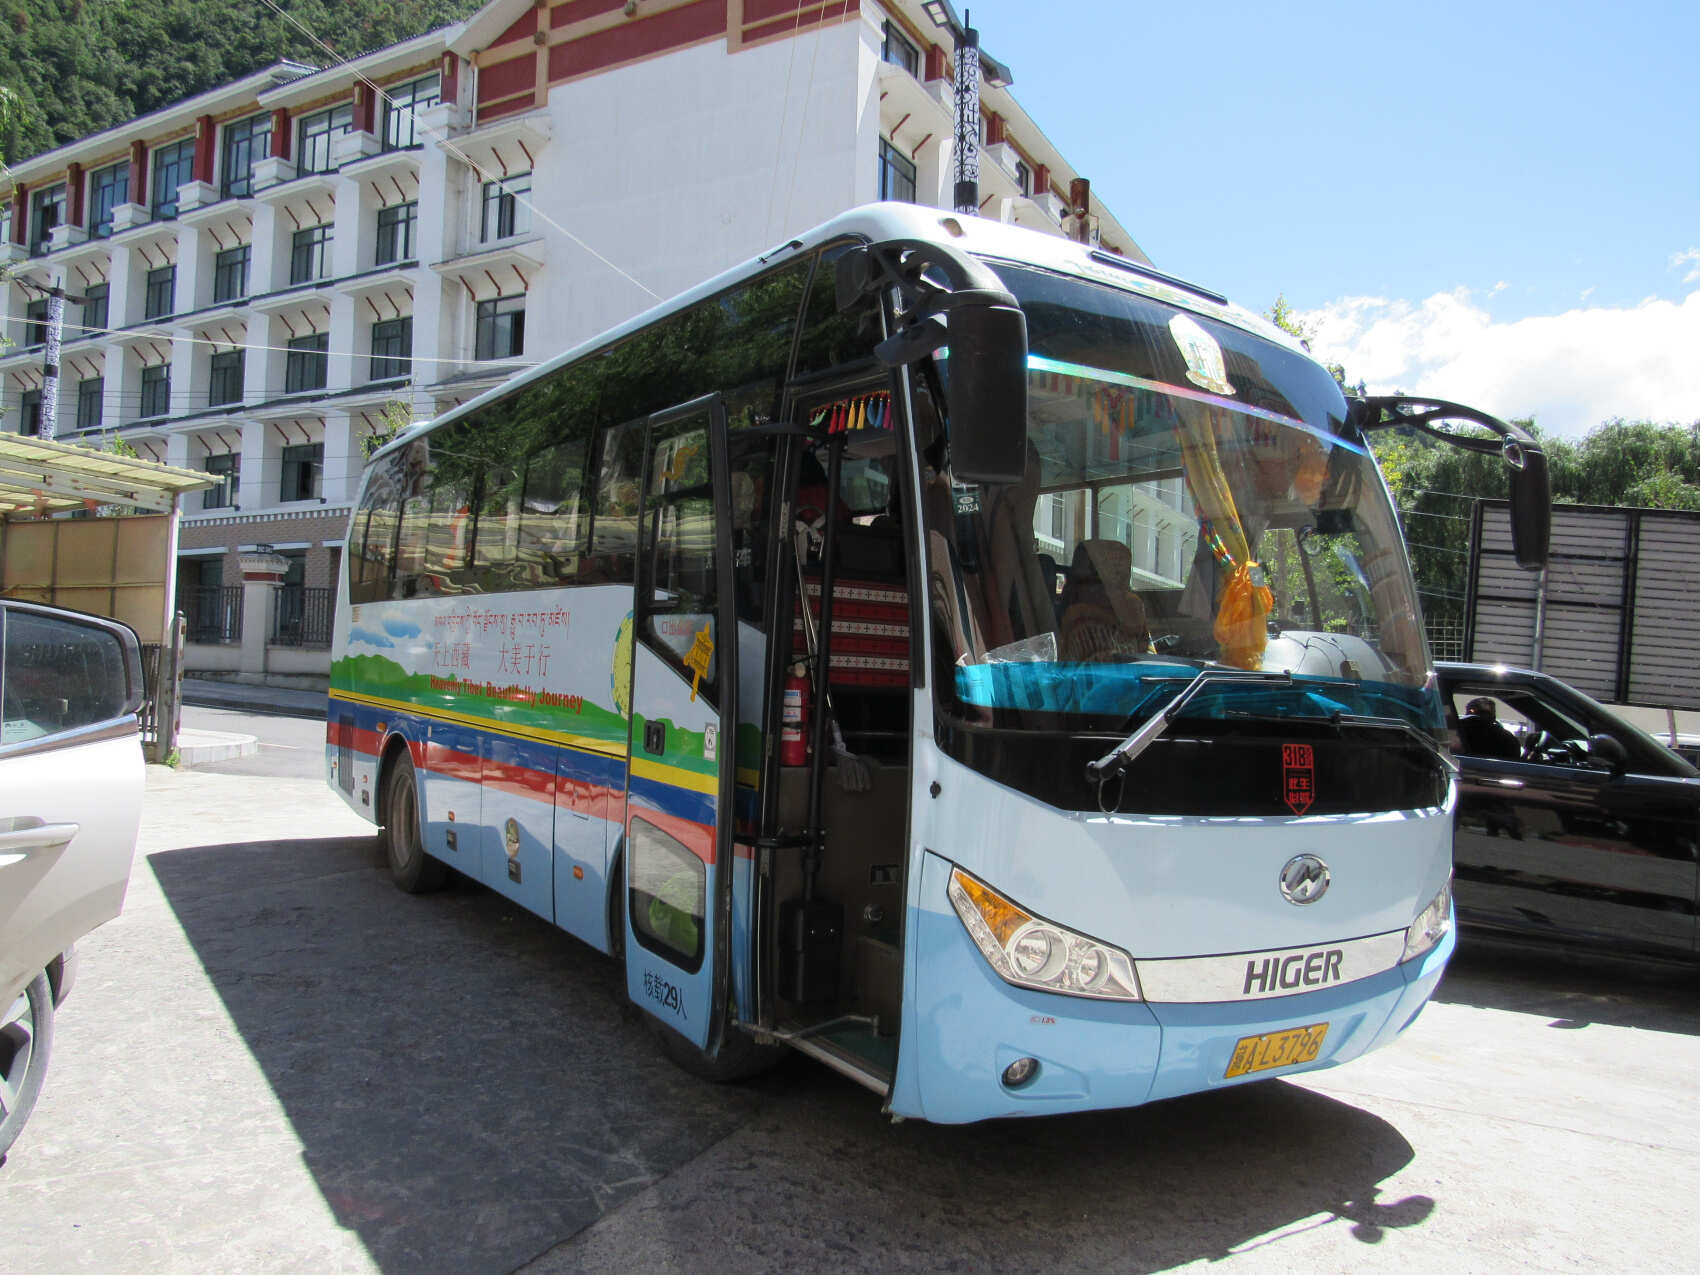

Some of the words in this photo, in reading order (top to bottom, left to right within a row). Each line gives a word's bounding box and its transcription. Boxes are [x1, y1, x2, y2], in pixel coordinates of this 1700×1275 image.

[957, 503, 979, 513] 2024
[497, 640, 551, 678] 大美于行
[486, 681, 537, 708] Beautifully
[539, 688, 583, 715] Journey
[1285, 745, 1305, 767] 318
[1243, 949, 1343, 994] HIGER
